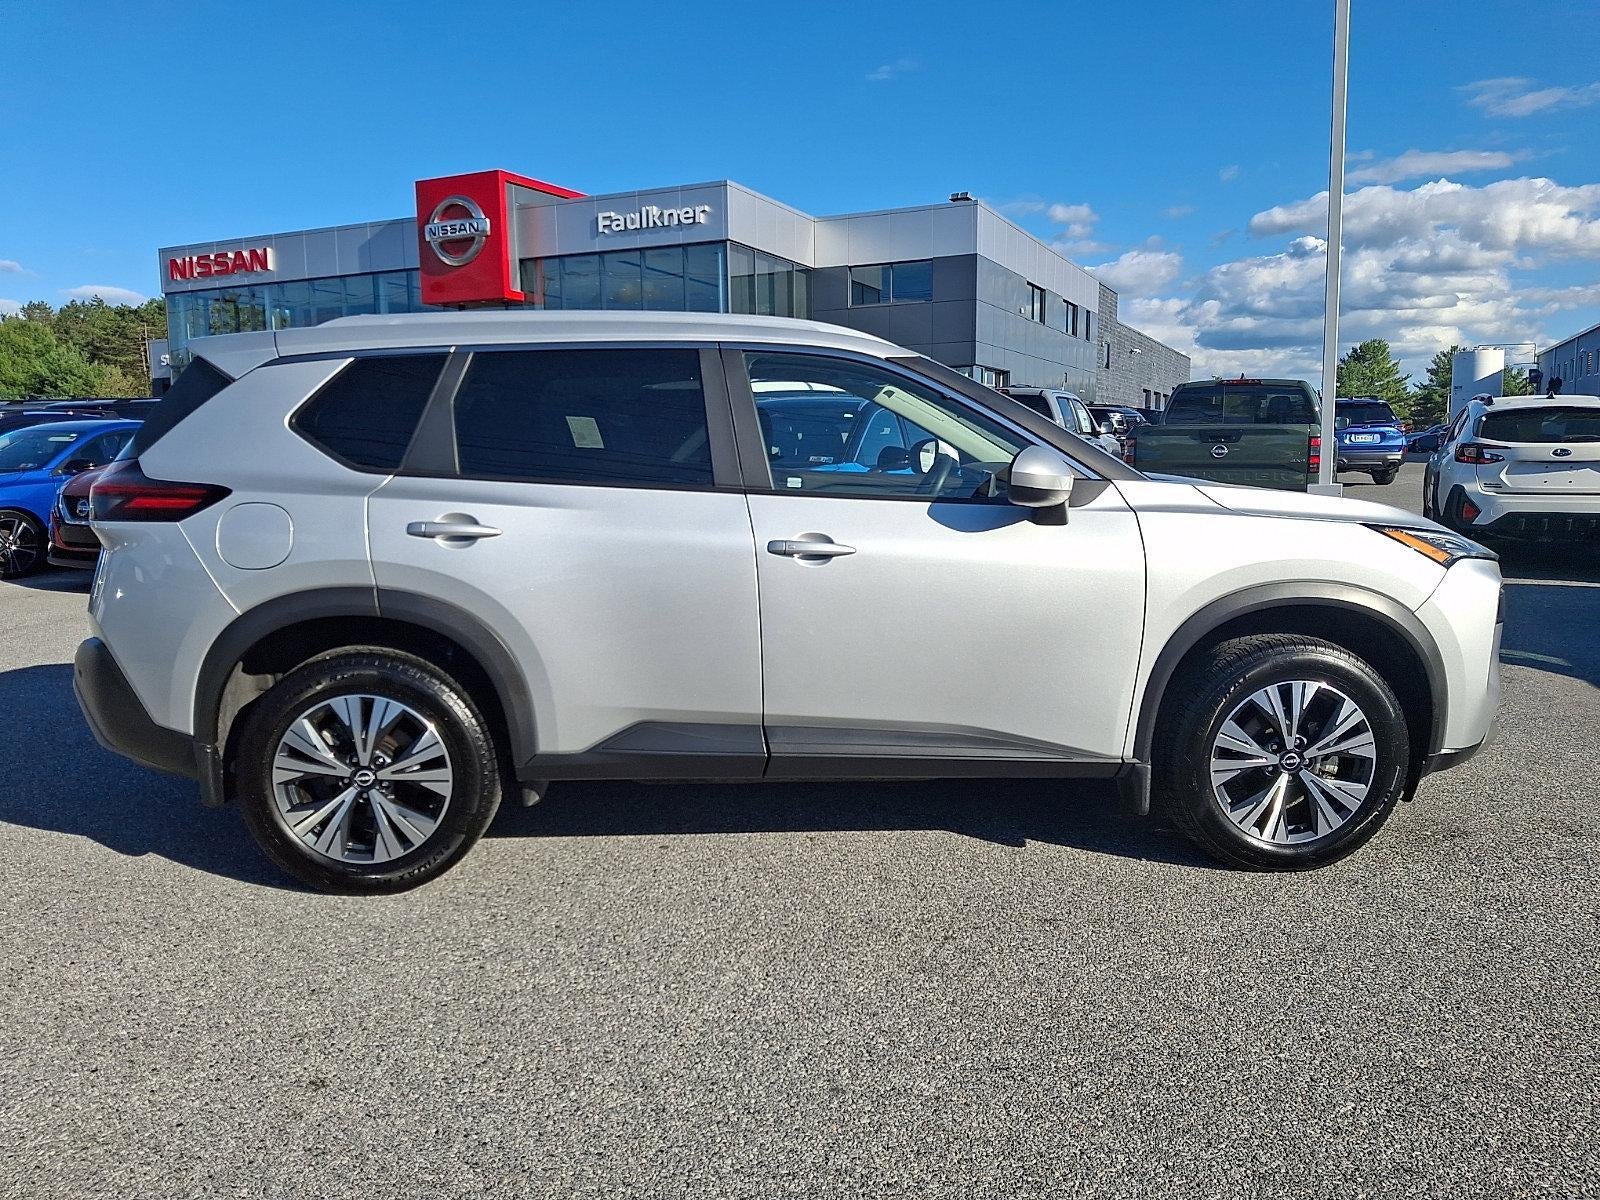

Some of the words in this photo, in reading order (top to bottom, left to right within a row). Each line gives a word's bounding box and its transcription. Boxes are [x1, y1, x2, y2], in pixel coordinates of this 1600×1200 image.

[428, 221, 480, 237] NISSAN
[598, 205, 710, 233] Faulkner
[169, 247, 271, 280] NISSAN
